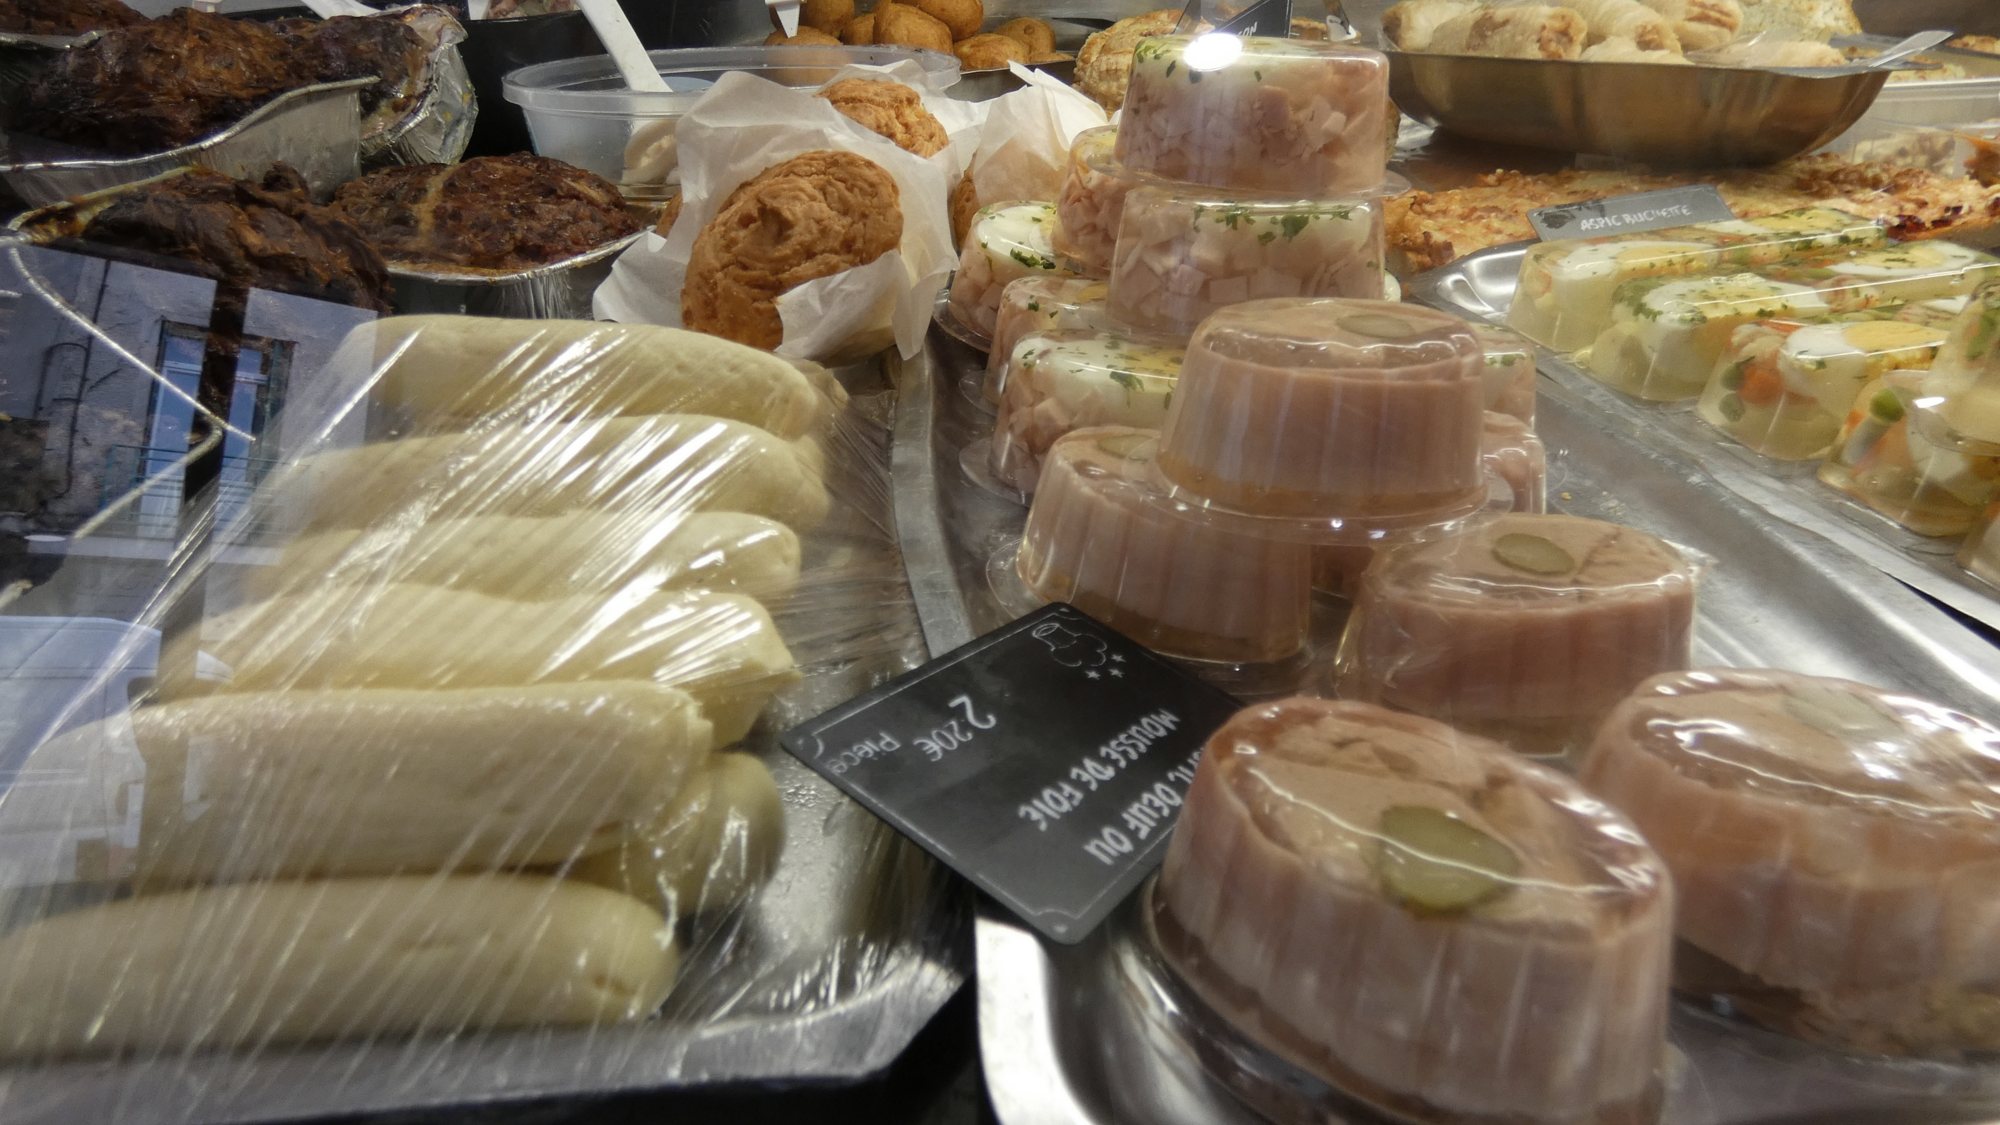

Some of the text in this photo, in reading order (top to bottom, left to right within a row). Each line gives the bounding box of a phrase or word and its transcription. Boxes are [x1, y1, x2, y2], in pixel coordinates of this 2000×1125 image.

[1580, 214, 1622, 232] ASPIC
[1018, 708, 1181, 832] MOUSSE DE FOIE
[1121, 782, 1183, 840] OEUF
[1083, 826, 1134, 865] OU
